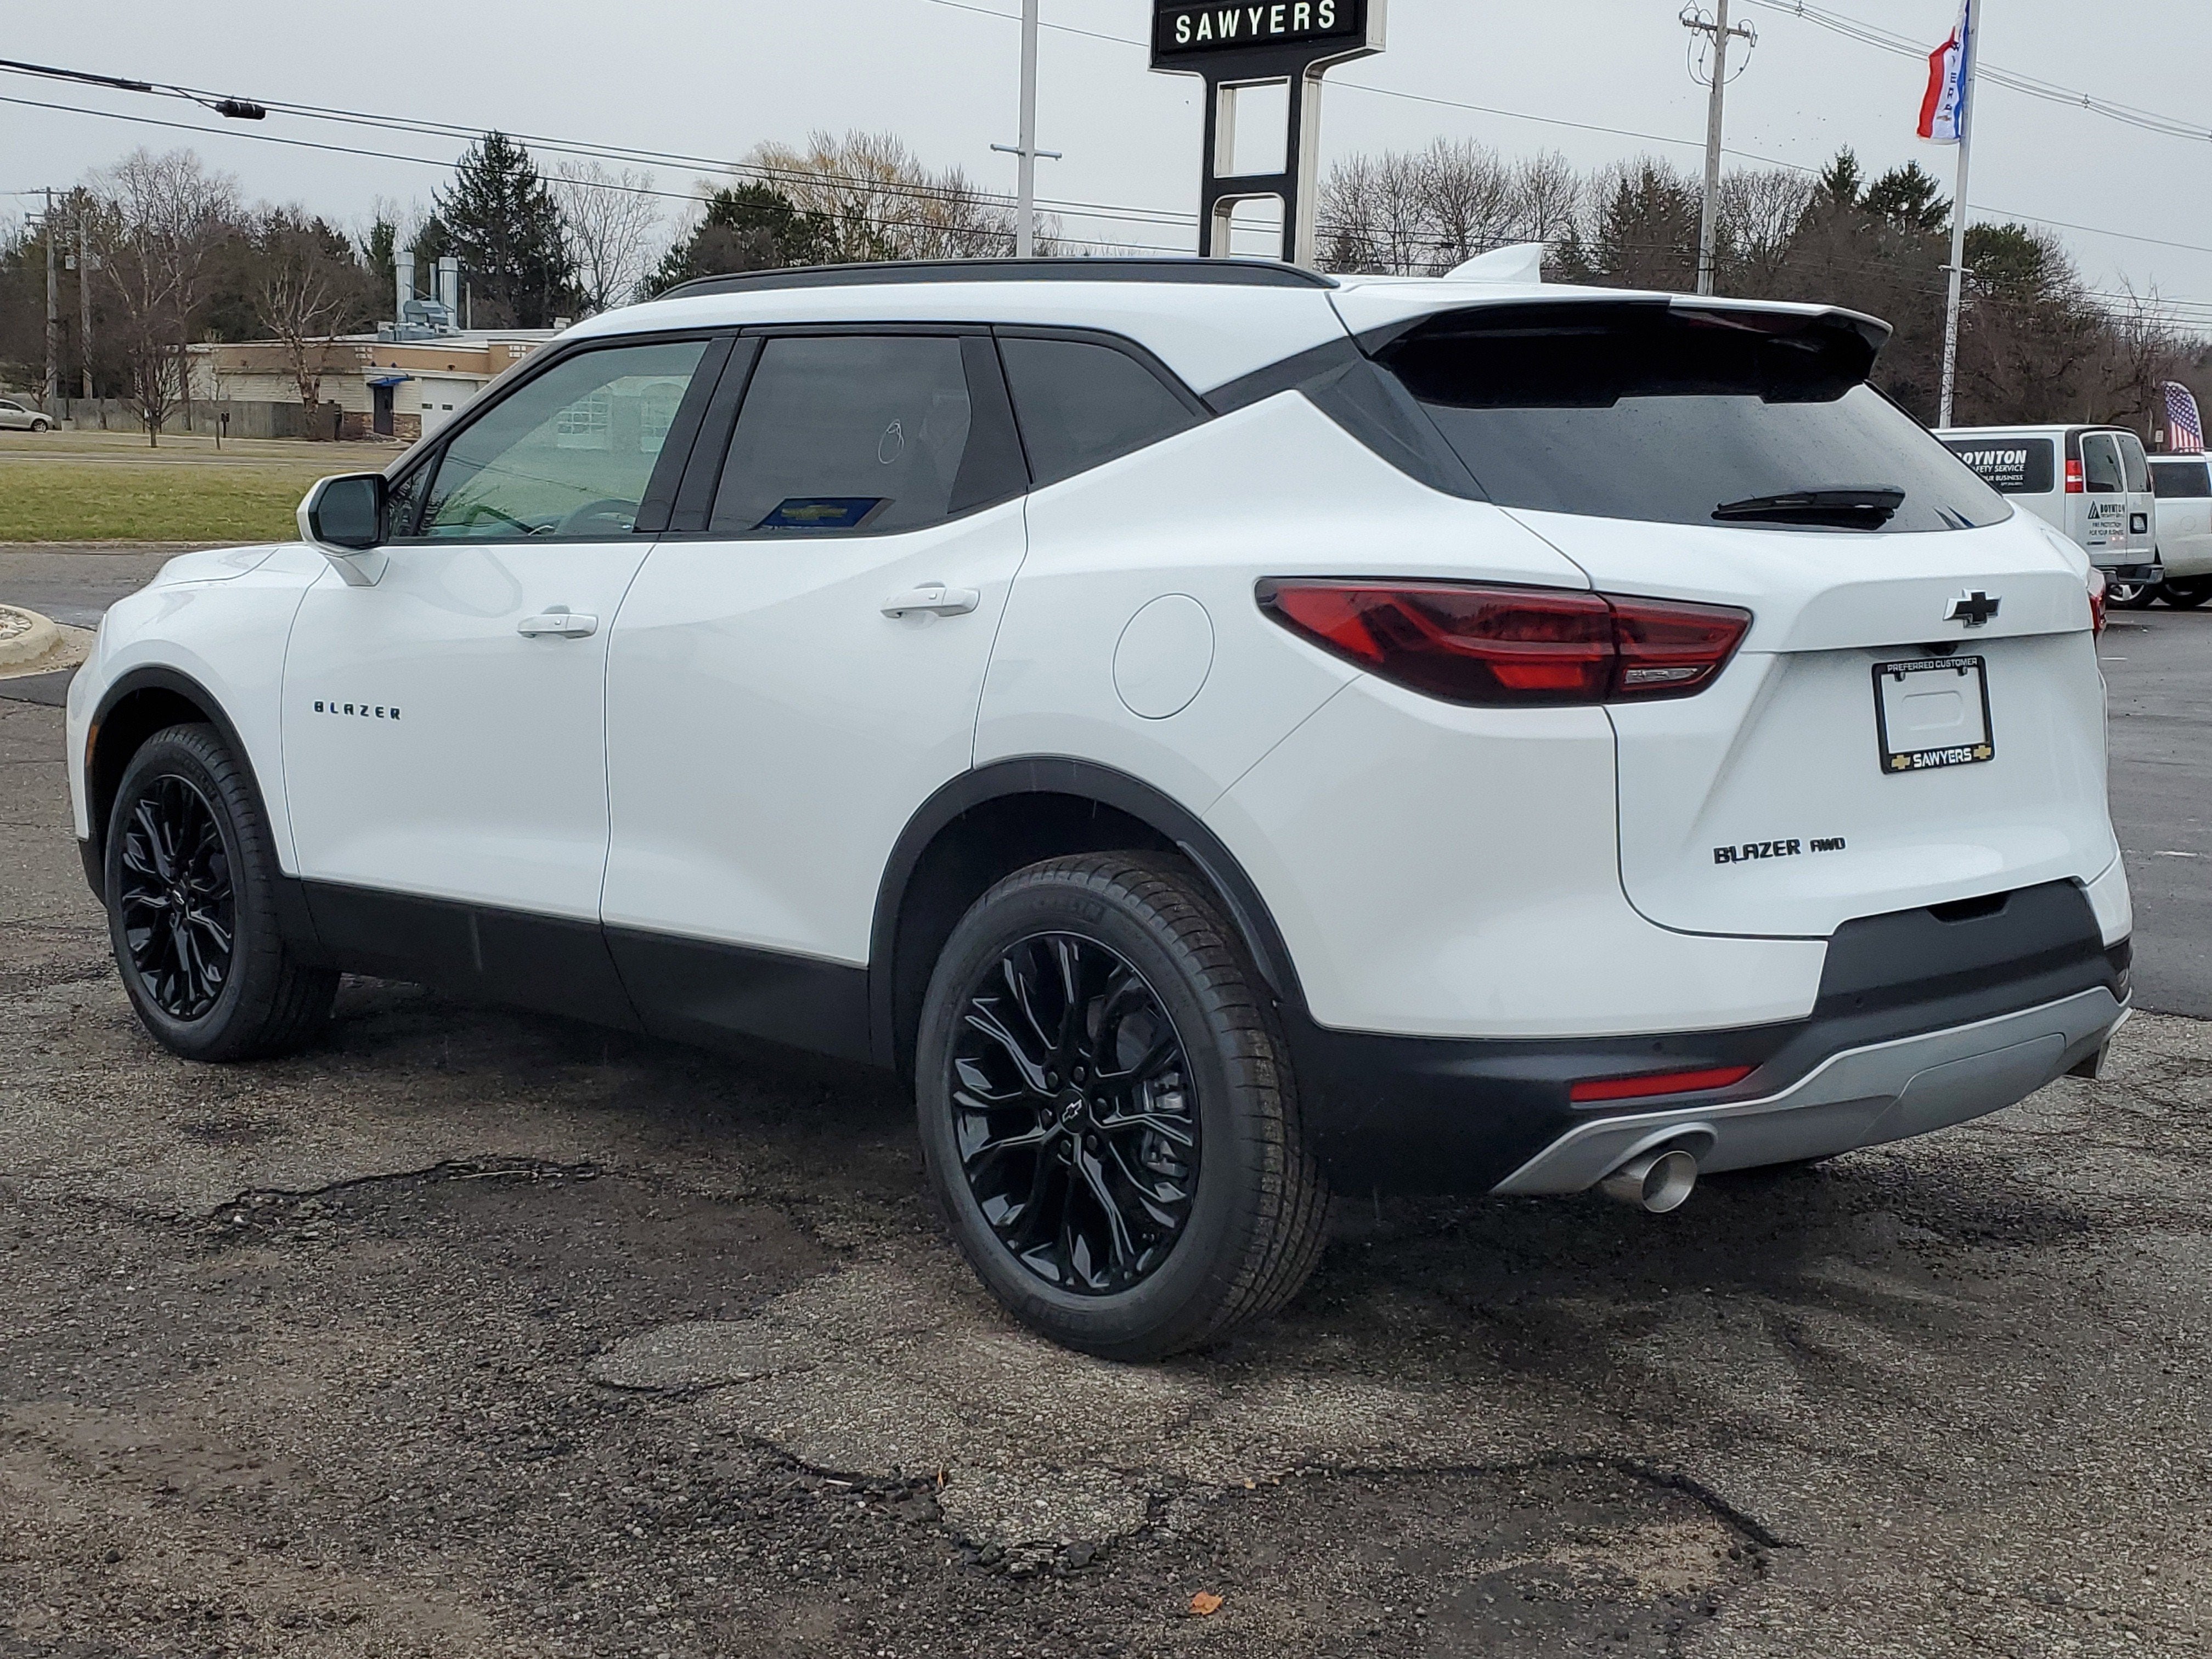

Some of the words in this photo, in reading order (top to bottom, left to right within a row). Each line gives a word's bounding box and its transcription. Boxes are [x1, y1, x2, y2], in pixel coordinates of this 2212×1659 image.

[1175, 0, 1335, 44] SAWYERS
[1994, 464, 2024, 472] SERVICE
[1887, 661, 1934, 673] PREFERRED
[1935, 657, 1977, 668] CUSTOMER
[314, 701, 400, 720] BLAZER
[1912, 747, 1972, 768] SAWYERS
[1713, 838, 1801, 865] BLAZER
[1809, 837, 1846, 853] AWD
